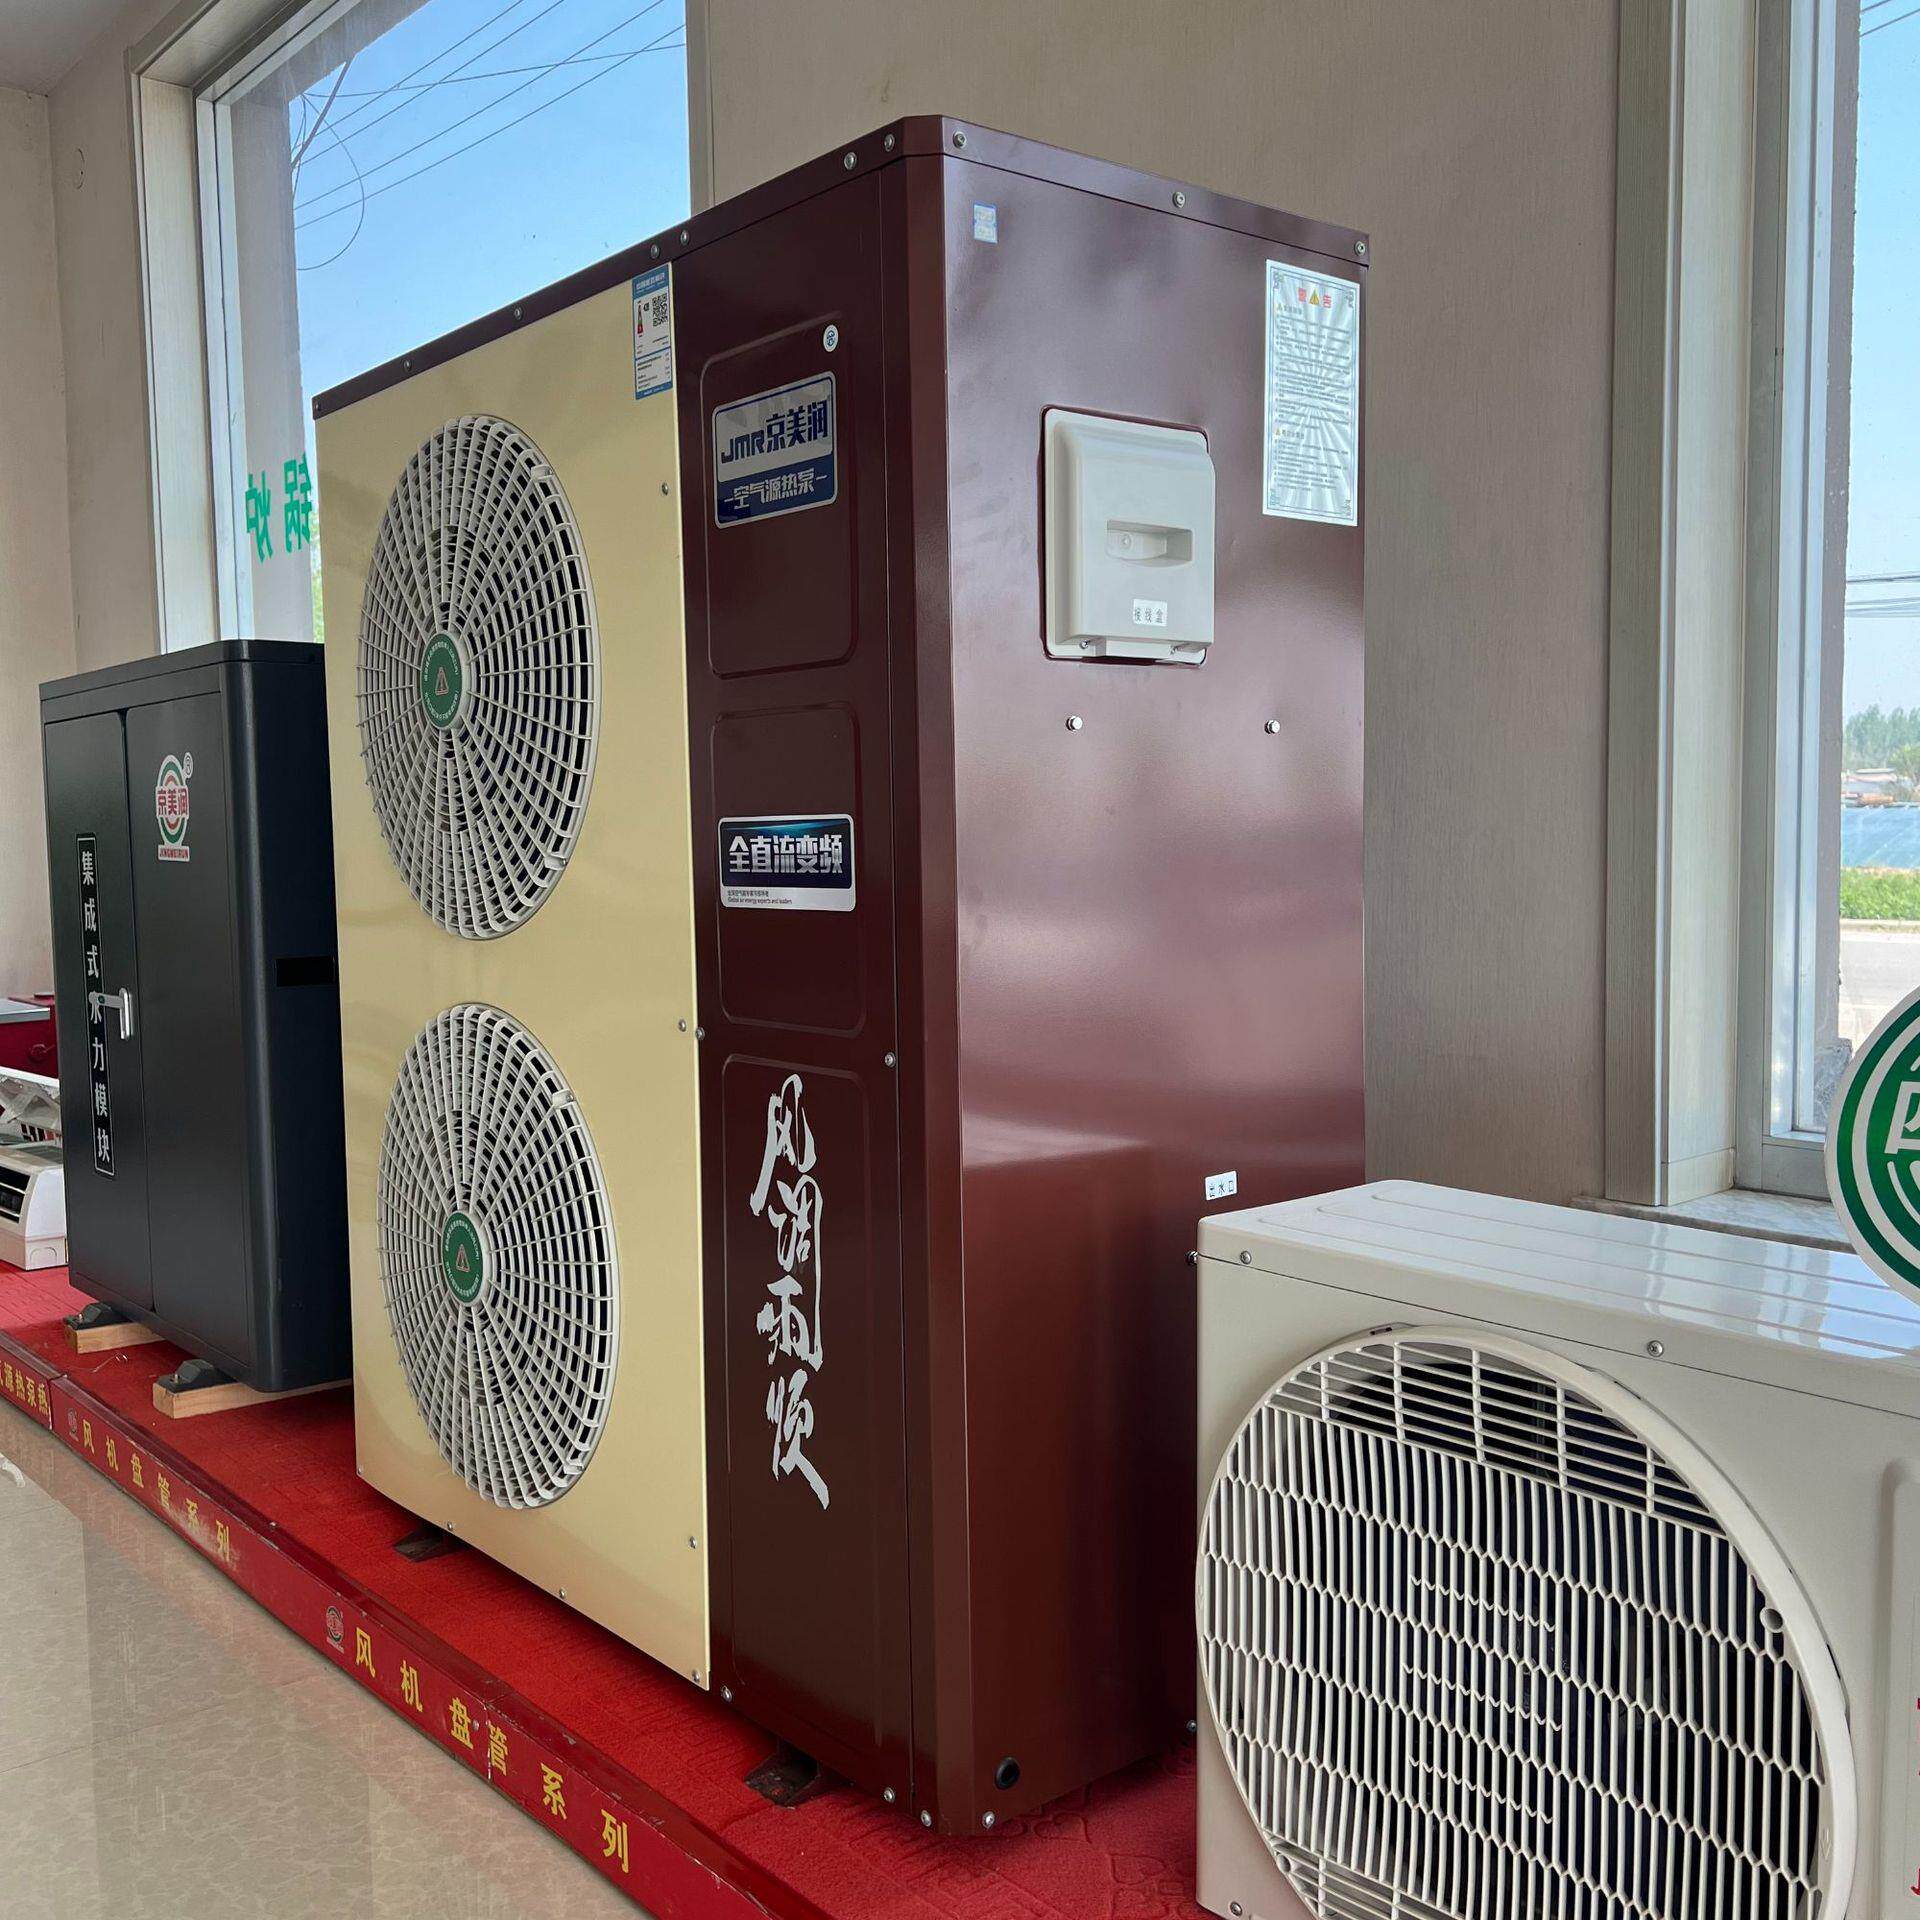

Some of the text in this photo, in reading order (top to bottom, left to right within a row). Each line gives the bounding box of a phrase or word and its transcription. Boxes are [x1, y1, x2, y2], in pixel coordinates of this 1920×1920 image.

[733, 467, 815, 510] 空气源热泵
[729, 834, 843, 874] 全直流变频
[750, 1074, 829, 1510] 风调雨顺
[0, 1361, 48, 1416] 源热泵热
[83, 1418, 231, 1563] 风机盘管系列
[354, 1626, 630, 1873] 风机盘管系列
